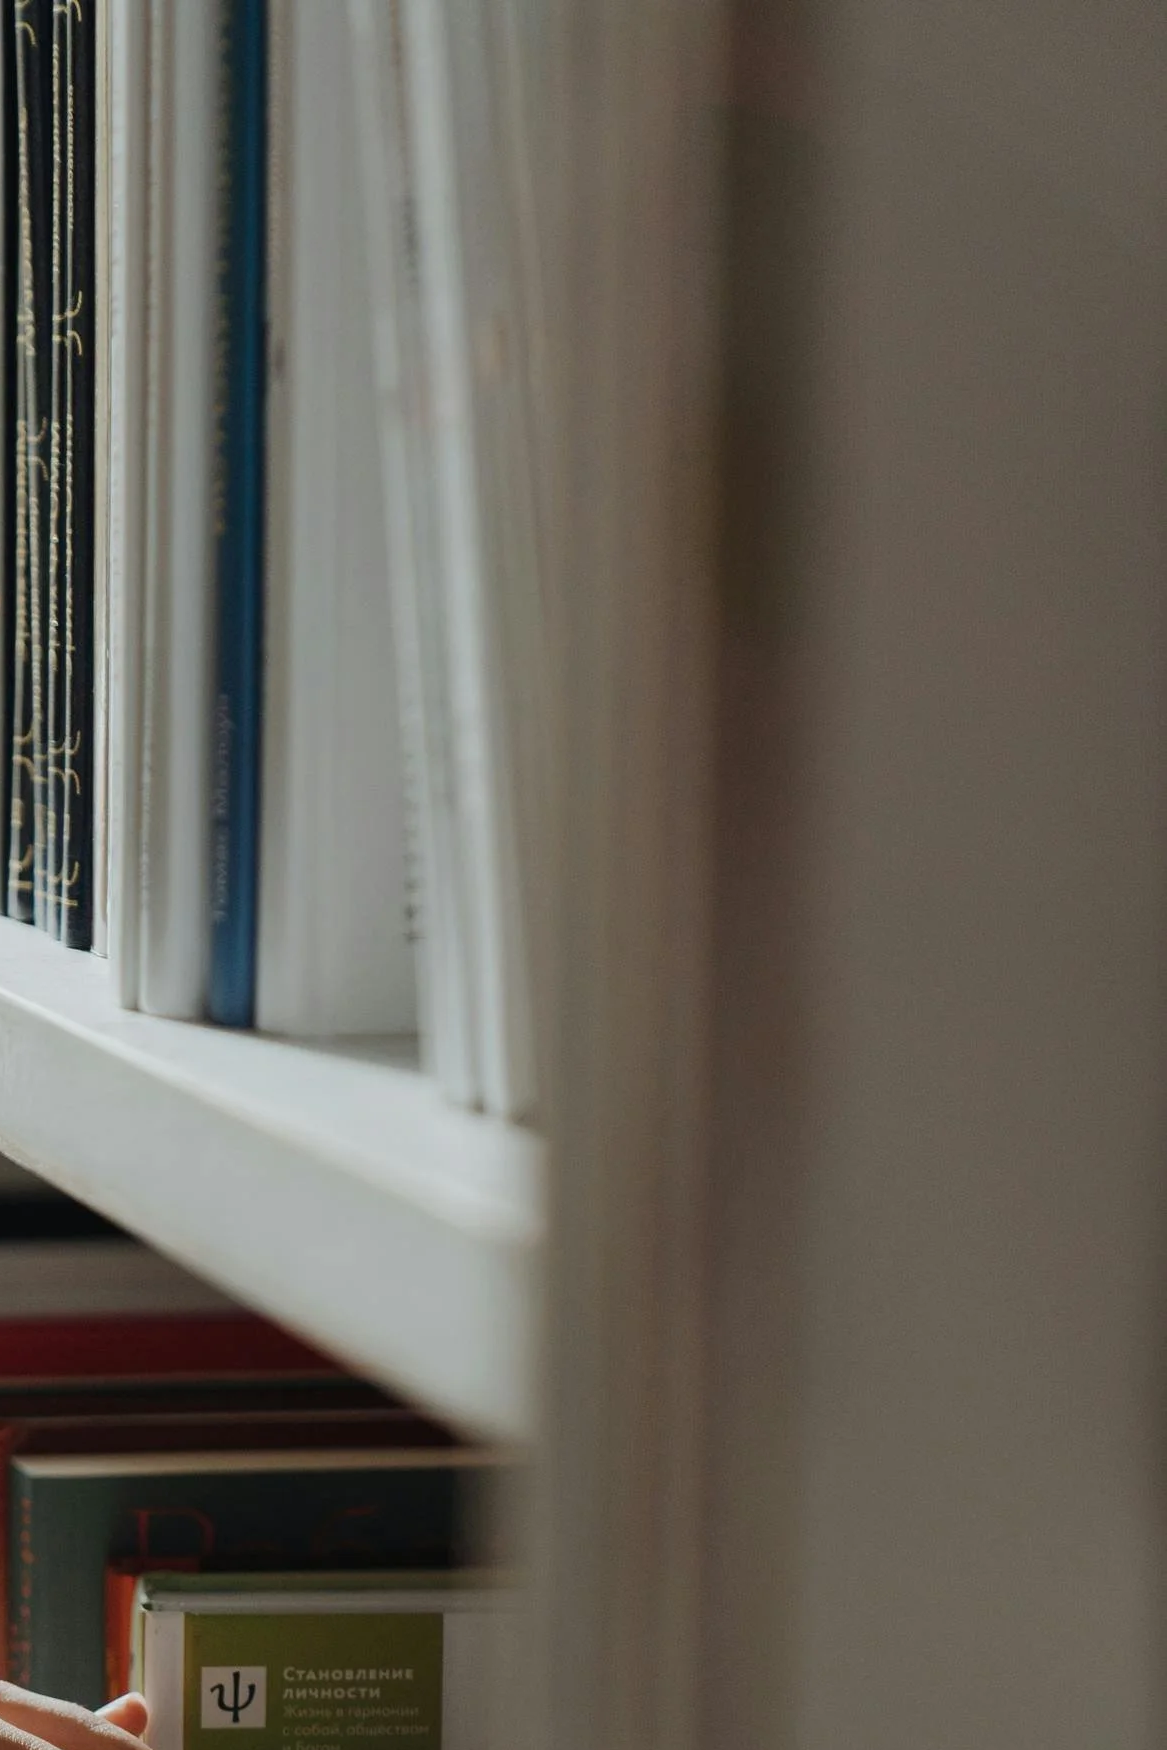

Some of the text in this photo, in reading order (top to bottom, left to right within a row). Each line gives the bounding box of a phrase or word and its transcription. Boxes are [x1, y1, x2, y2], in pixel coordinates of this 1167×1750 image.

[282, 1703, 420, 1720] Жизнь в гармонии
[282, 1722, 431, 1738] с собой, обществом
